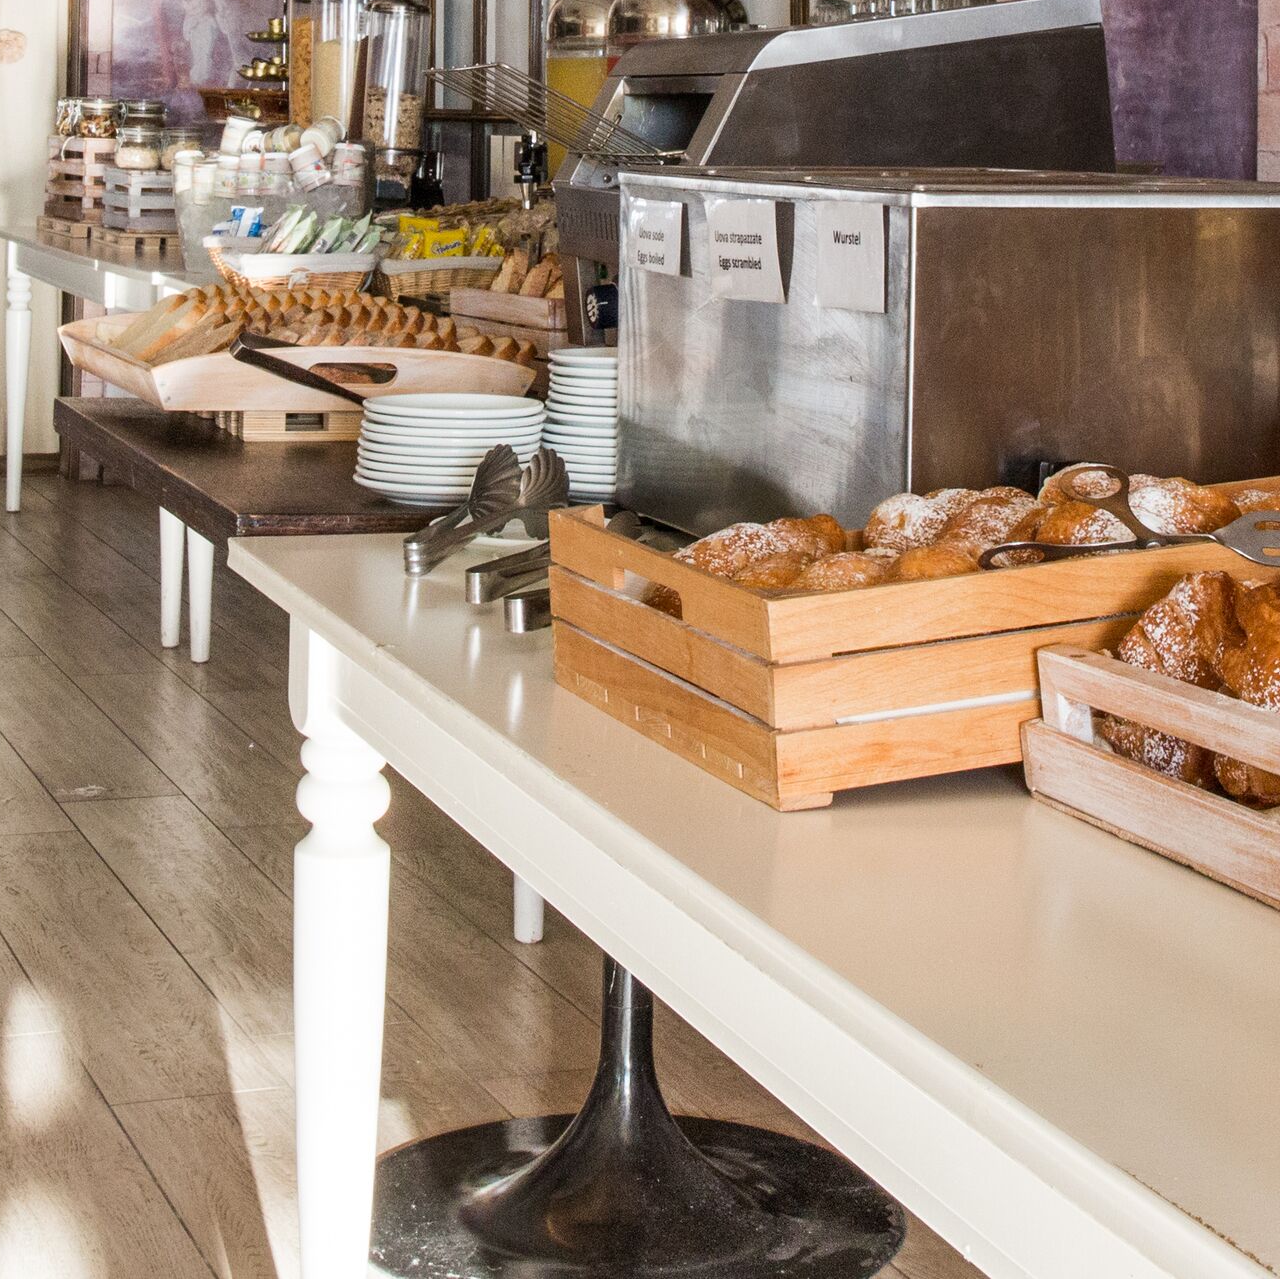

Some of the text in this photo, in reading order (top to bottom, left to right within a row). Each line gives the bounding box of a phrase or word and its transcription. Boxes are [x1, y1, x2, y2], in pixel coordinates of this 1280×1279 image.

[715, 230, 762, 246] Uova strapazzate
[833, 230, 860, 245] Wurstel
[638, 250, 664, 265] Eggs boiled
[719, 255, 762, 270] Eggs scrambled
